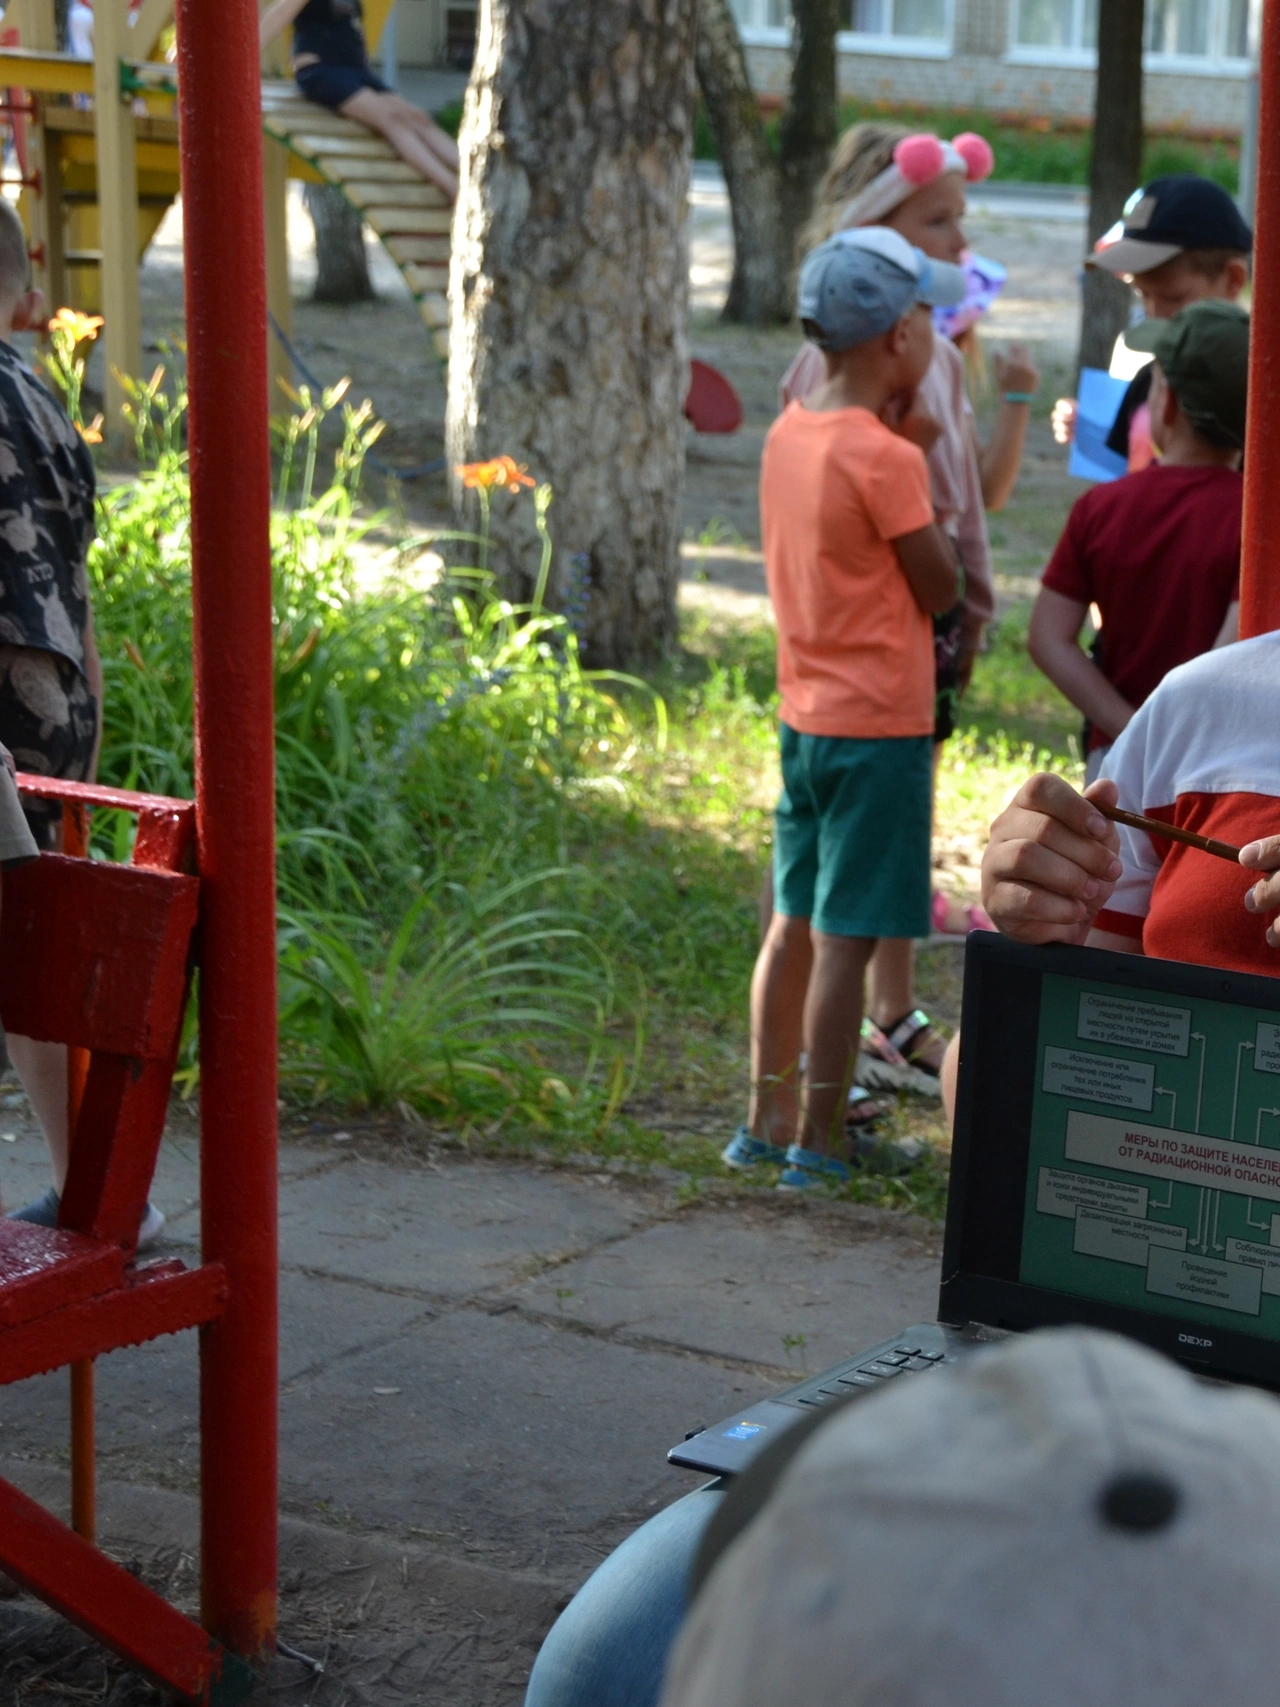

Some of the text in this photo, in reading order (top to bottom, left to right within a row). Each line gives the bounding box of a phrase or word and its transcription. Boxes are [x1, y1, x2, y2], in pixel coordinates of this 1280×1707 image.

[1098, 1011, 1122, 1022] людей
[1135, 1016, 1170, 1028] открытой
[1087, 1018, 1180, 1041] местности путем укрытия
[1069, 1053, 1129, 1071] Исключение или
[1074, 1076, 1121, 1091] тех или иных
[1060, 1084, 1133, 1104] пищевых продуктов
[1124, 1132, 1159, 1149] МЕРЫ
[1161, 1140, 1178, 1152] ПО
[1181, 1143, 1228, 1163] ЗАЩИТЕ
[1118, 1146, 1135, 1157] ОТ
[1136, 1148, 1231, 1177] РАДИАЦИОННОЙ
[1111, 1228, 1149, 1241] местности
[1239, 1254, 1266, 1266] правил
[1181, 1261, 1228, 1278] Проведение
[1176, 1281, 1229, 1300] профилактики
[1178, 1333, 1212, 1348] DEXP
